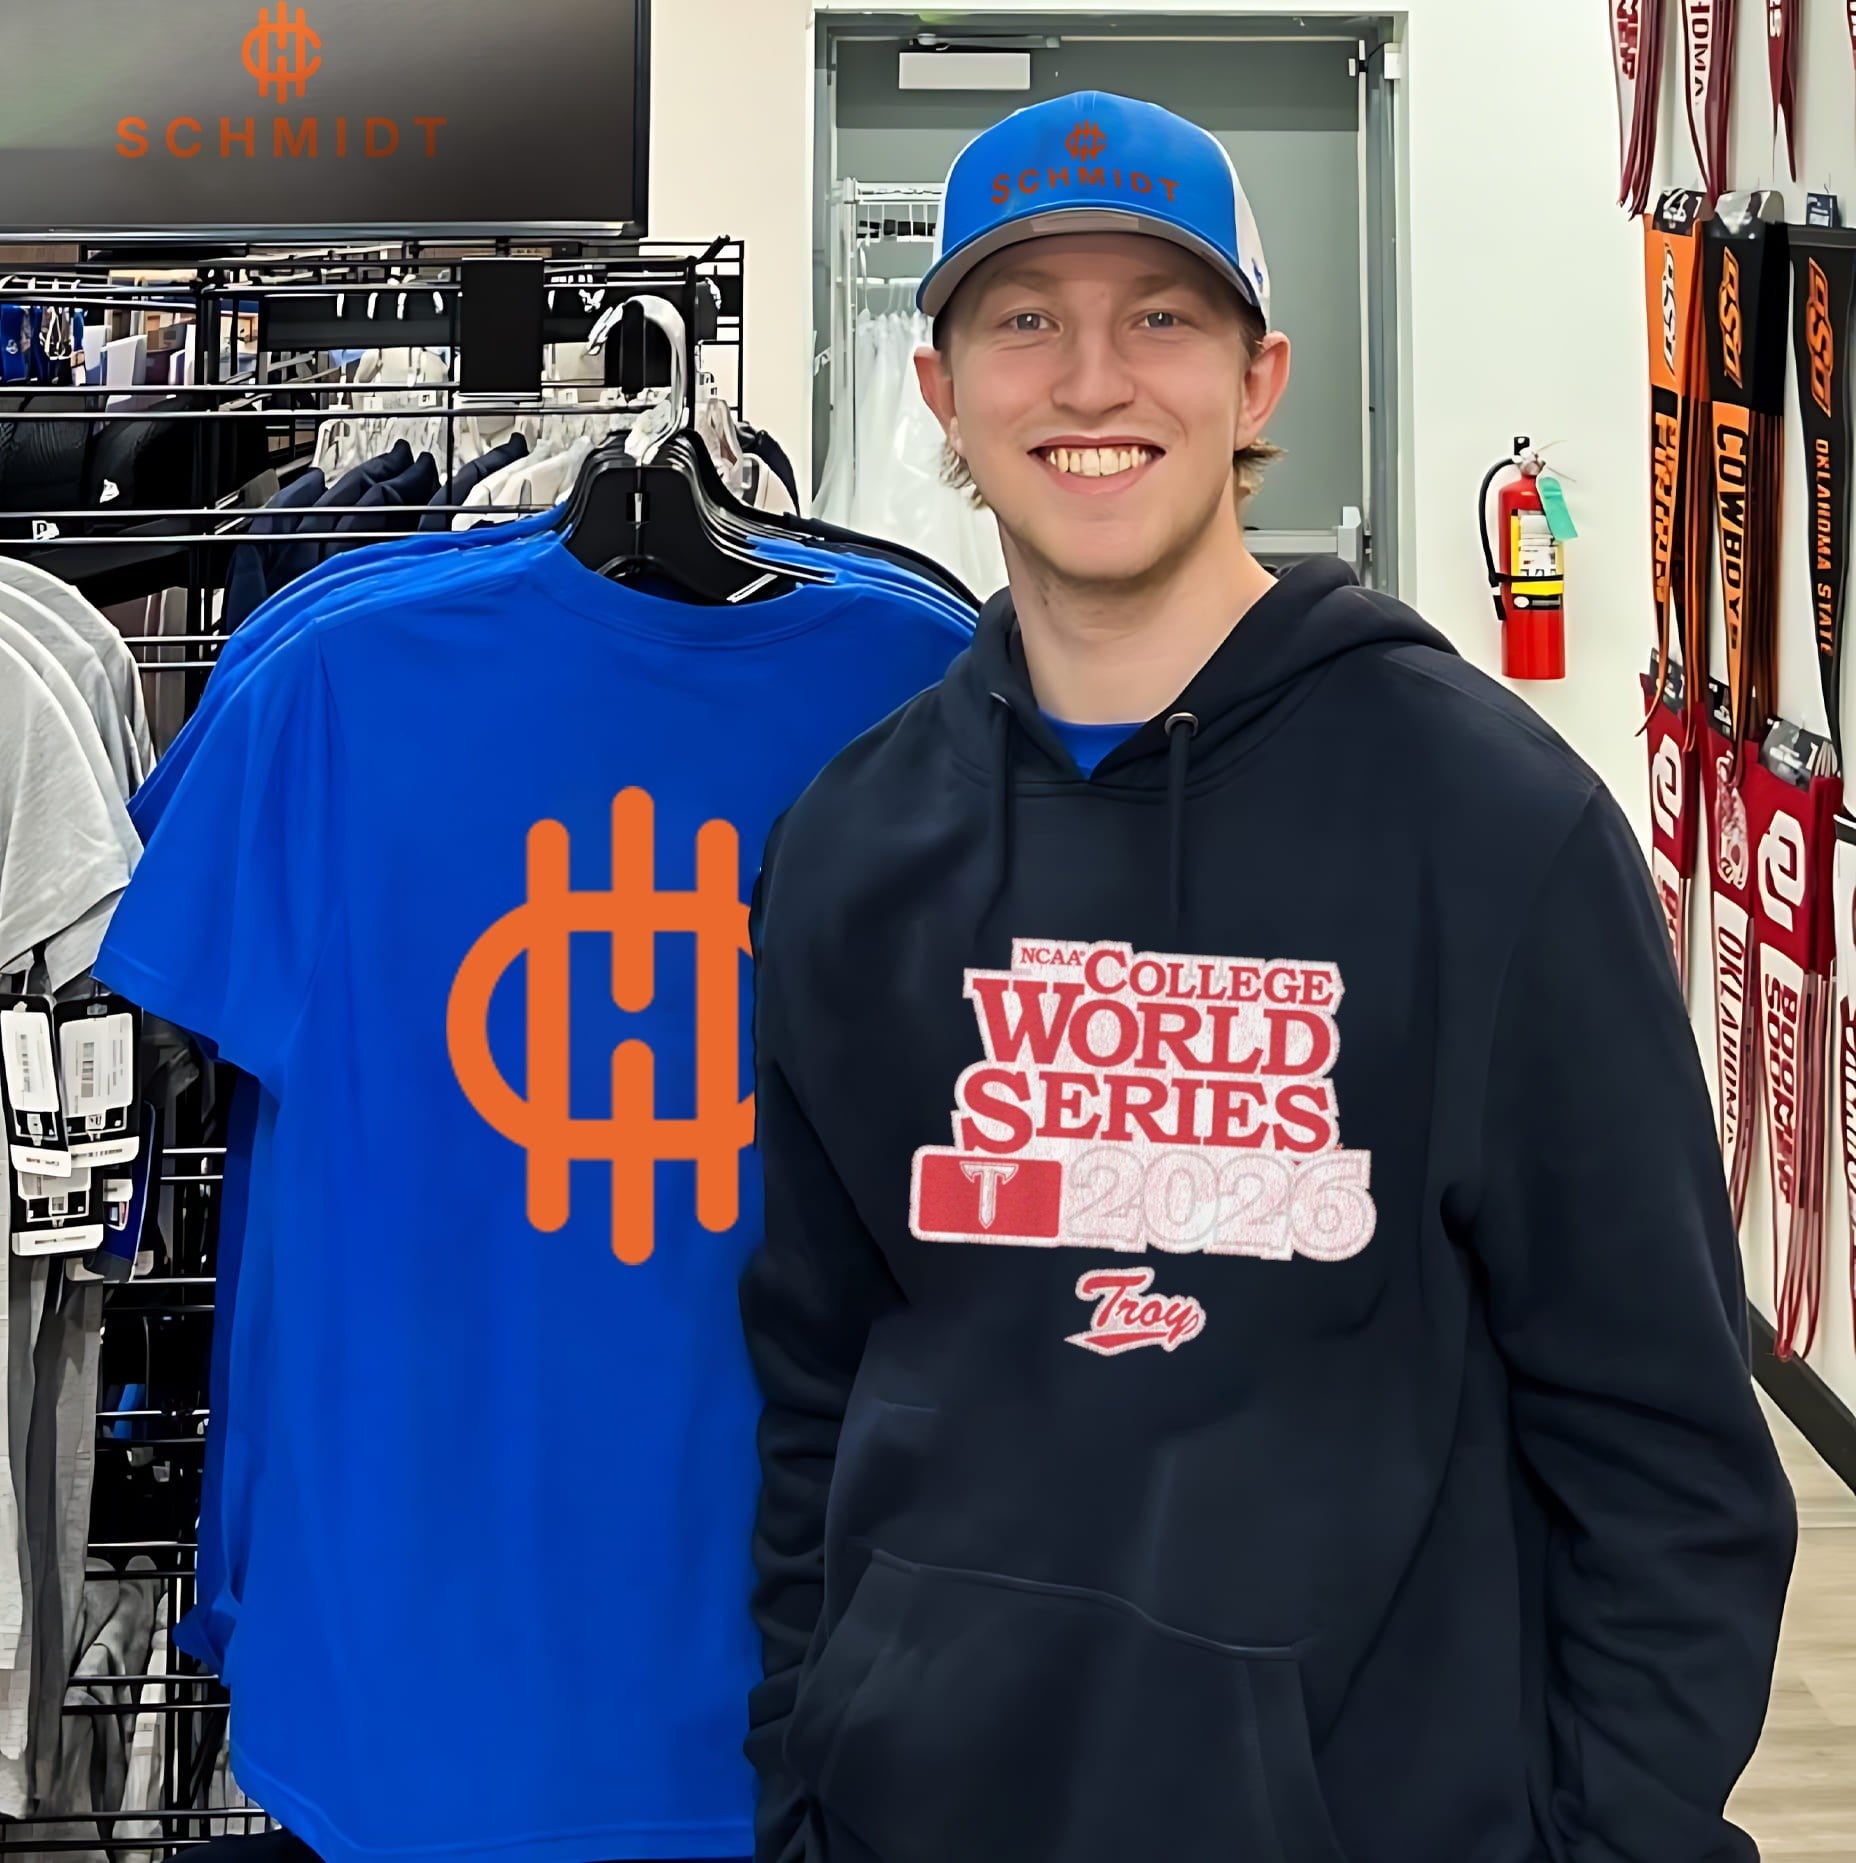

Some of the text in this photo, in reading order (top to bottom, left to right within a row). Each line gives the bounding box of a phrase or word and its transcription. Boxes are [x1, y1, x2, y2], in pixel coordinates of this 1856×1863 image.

[115, 116, 449, 159] SCHMIDT
[991, 167, 1179, 205] SCHMIDT
[1084, 949, 1335, 1007] COLLEGE
[972, 977, 1333, 1077] WORLD
[960, 1067, 1333, 1155] SERIES
[1064, 1145, 1373, 1258] 2026
[1081, 1273, 1202, 1344] Troy
